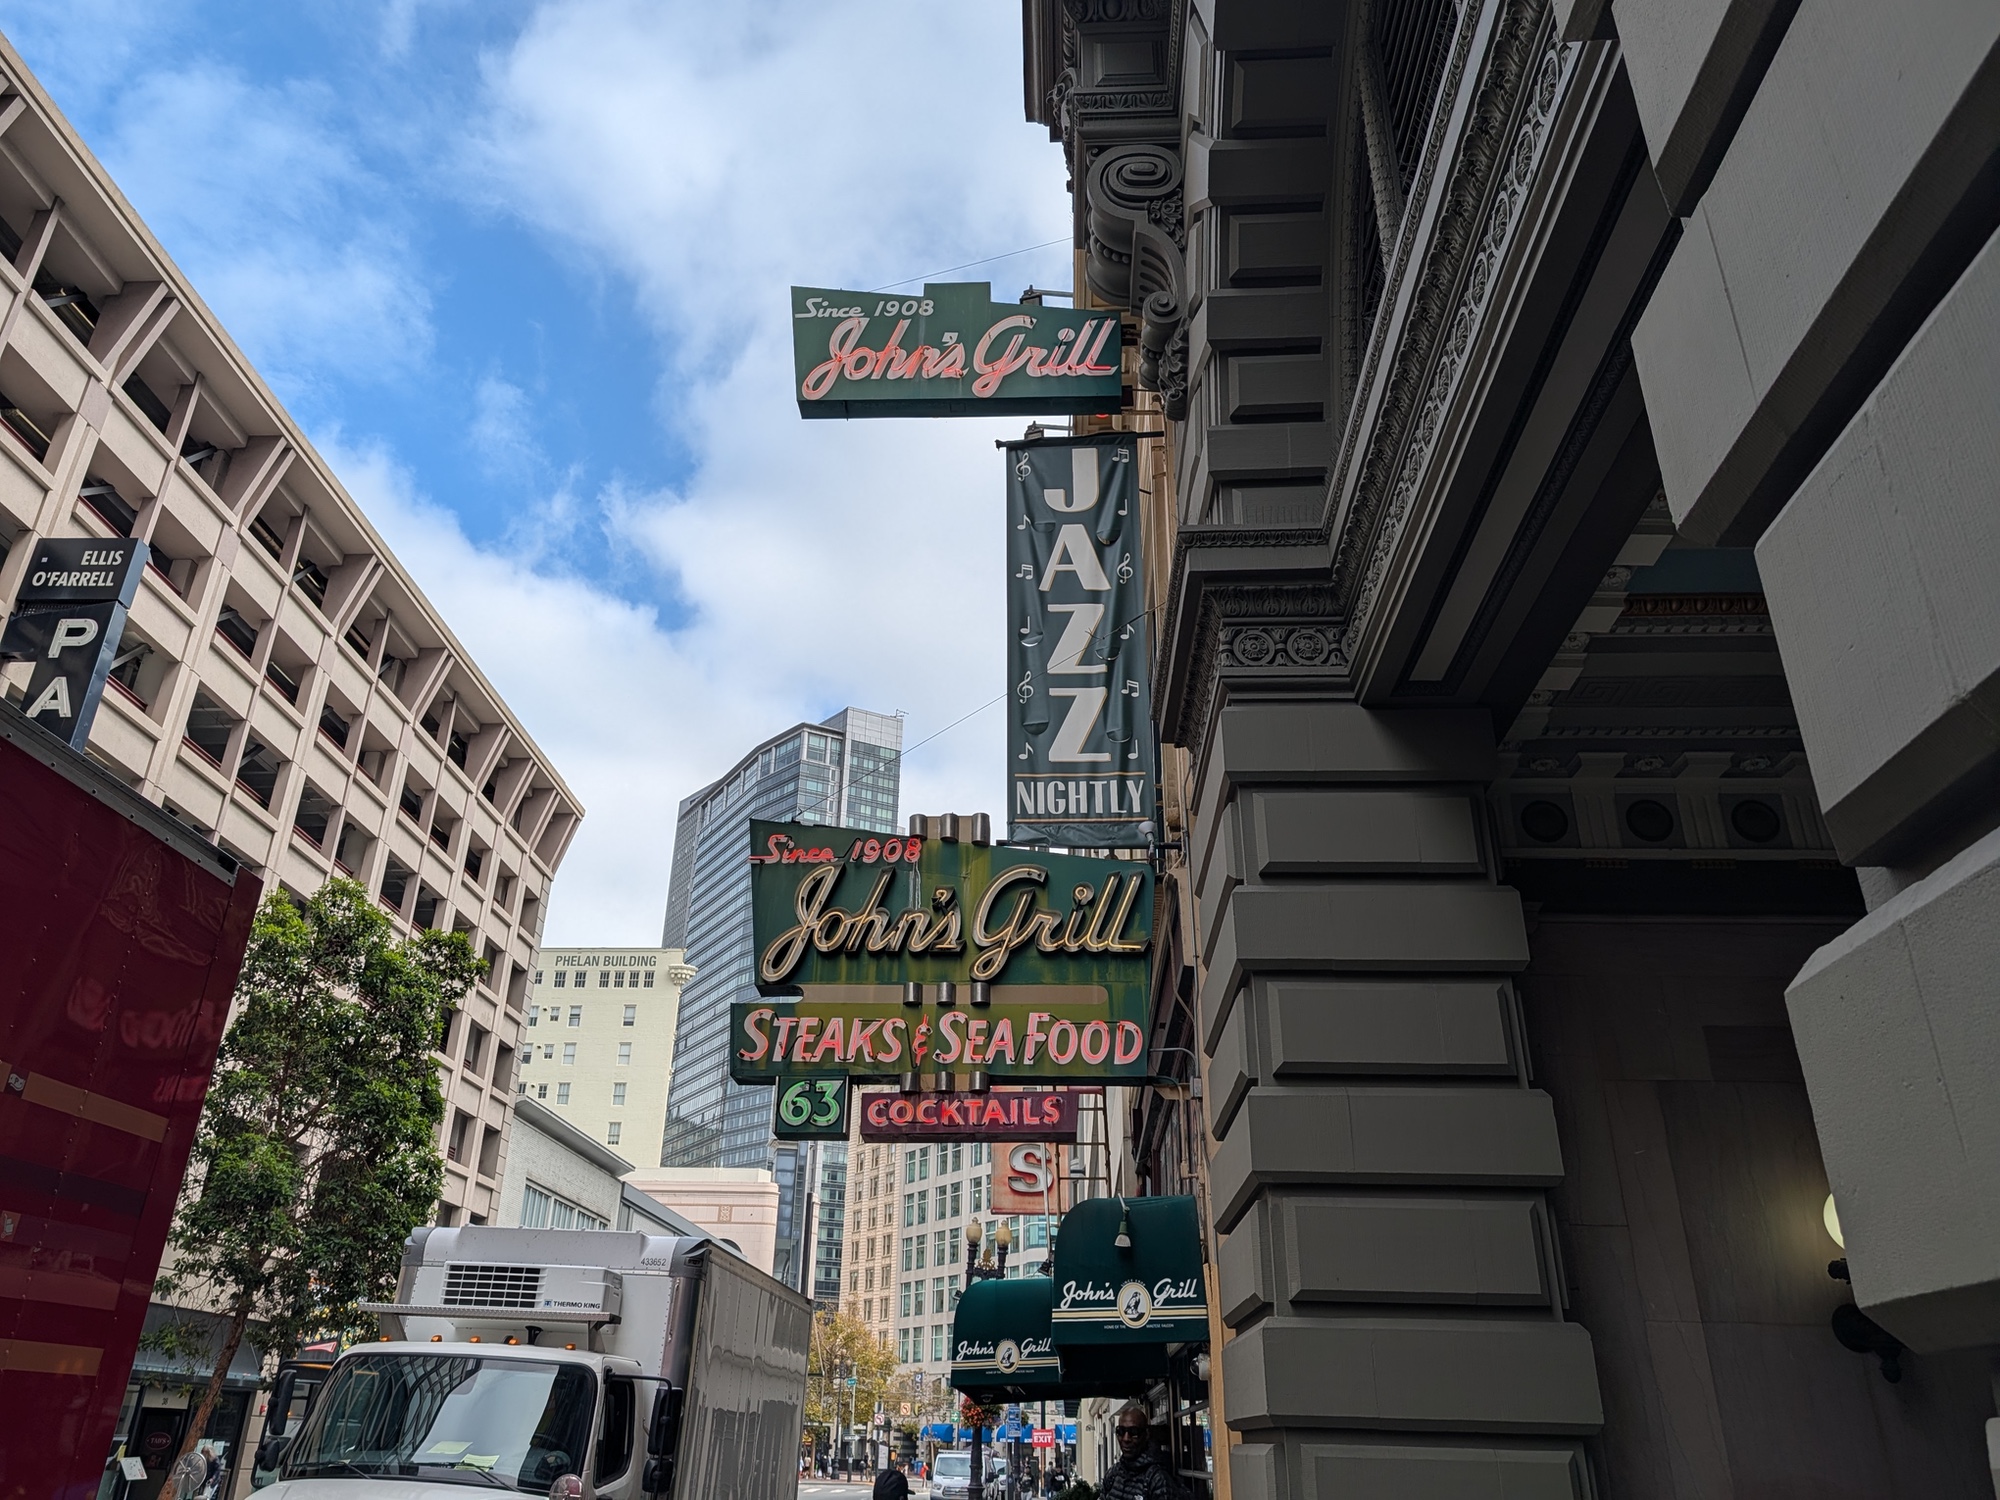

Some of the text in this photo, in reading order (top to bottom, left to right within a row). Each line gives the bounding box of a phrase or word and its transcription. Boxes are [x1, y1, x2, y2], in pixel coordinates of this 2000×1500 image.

[795, 298, 935, 318] Since 1908
[802, 315, 1119, 401] John's Grill
[81, 550, 124, 566] ELLIS
[32, 571, 115, 587] O'FARRELL
[1038, 448, 1113, 763] JAZZ
[1016, 779, 1145, 815] NIGHTLY
[749, 833, 922, 865] Since 1908
[760, 862, 1151, 983] John's Grill
[555, 955, 657, 967] PHELAN BUILDING
[738, 1009, 907, 1063] STEAKS
[912, 1013, 934, 1068] &
[779, 1080, 842, 1128] 63
[867, 1095, 1060, 1127] COCKTAILS
[640, 1258, 667, 1266] 433652
[1060, 1278, 1198, 1309] John's Grill
[956, 1337, 1052, 1361] John's Grill
[1033, 1435, 1052, 1443] EXIT
